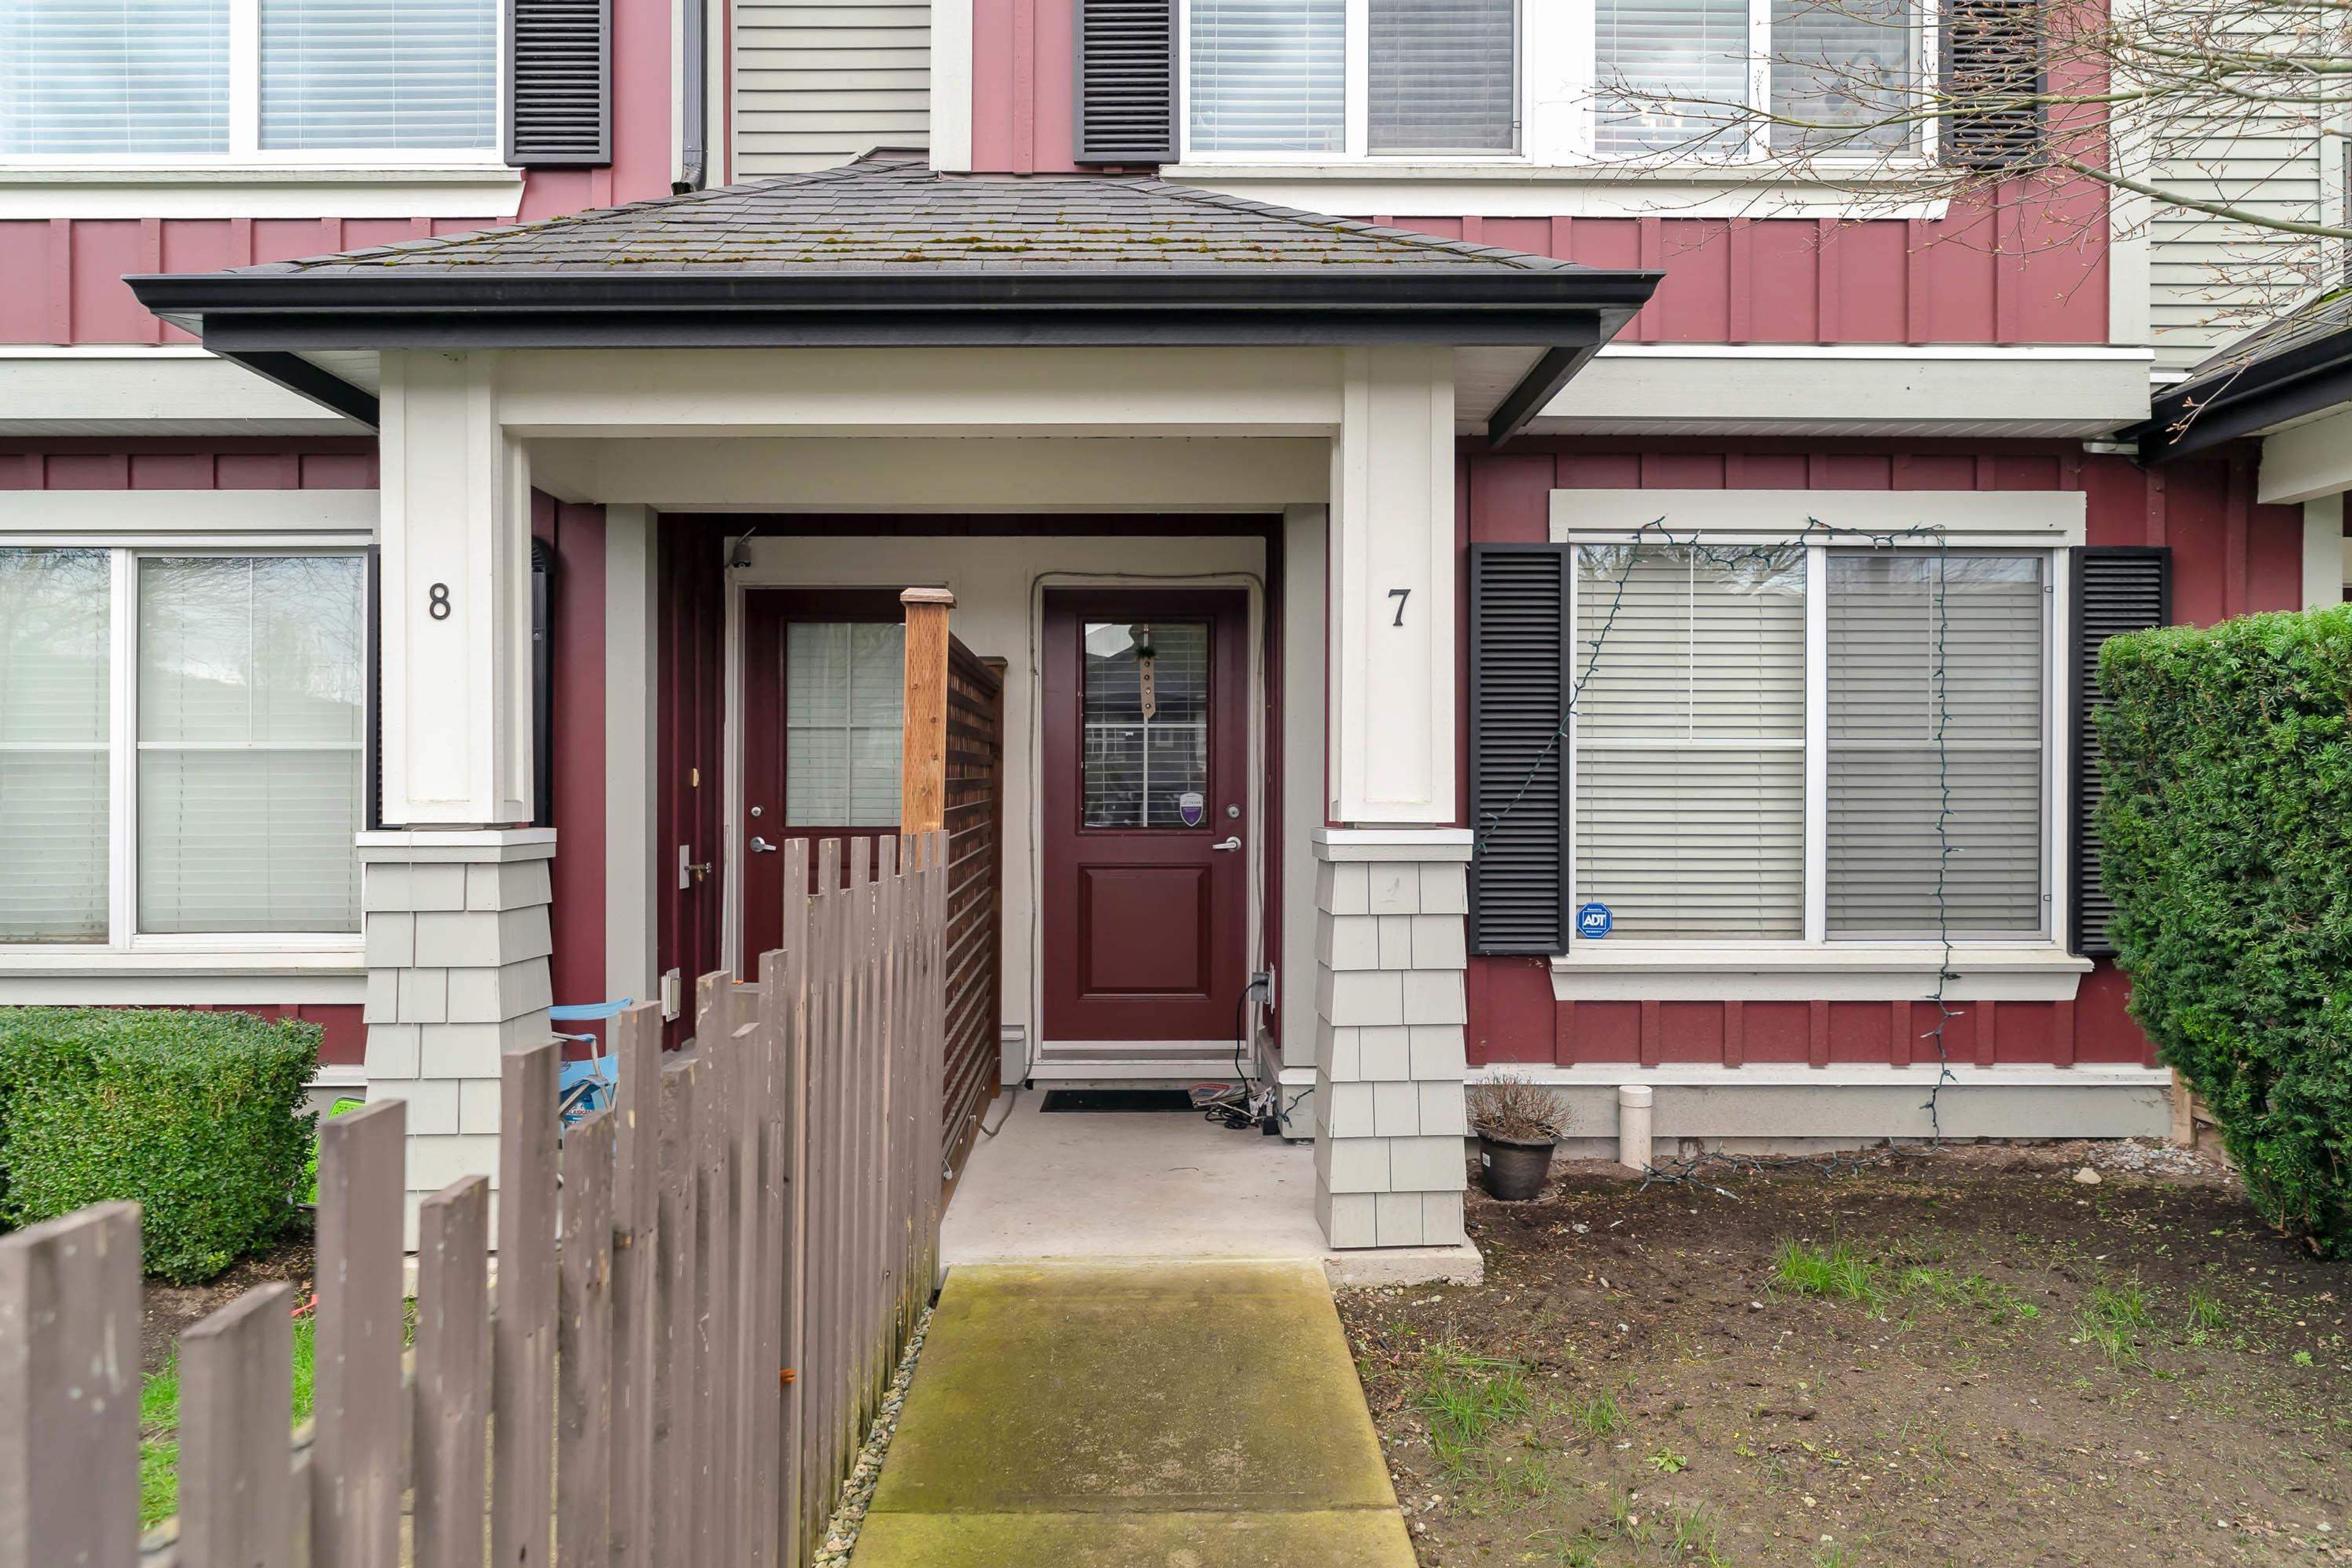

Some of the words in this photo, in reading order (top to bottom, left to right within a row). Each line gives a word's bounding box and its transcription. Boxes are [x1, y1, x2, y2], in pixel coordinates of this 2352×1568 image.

[429, 582, 451, 620] 8
[1388, 589, 1411, 627] 7
[1583, 914, 1606, 926] ADT
